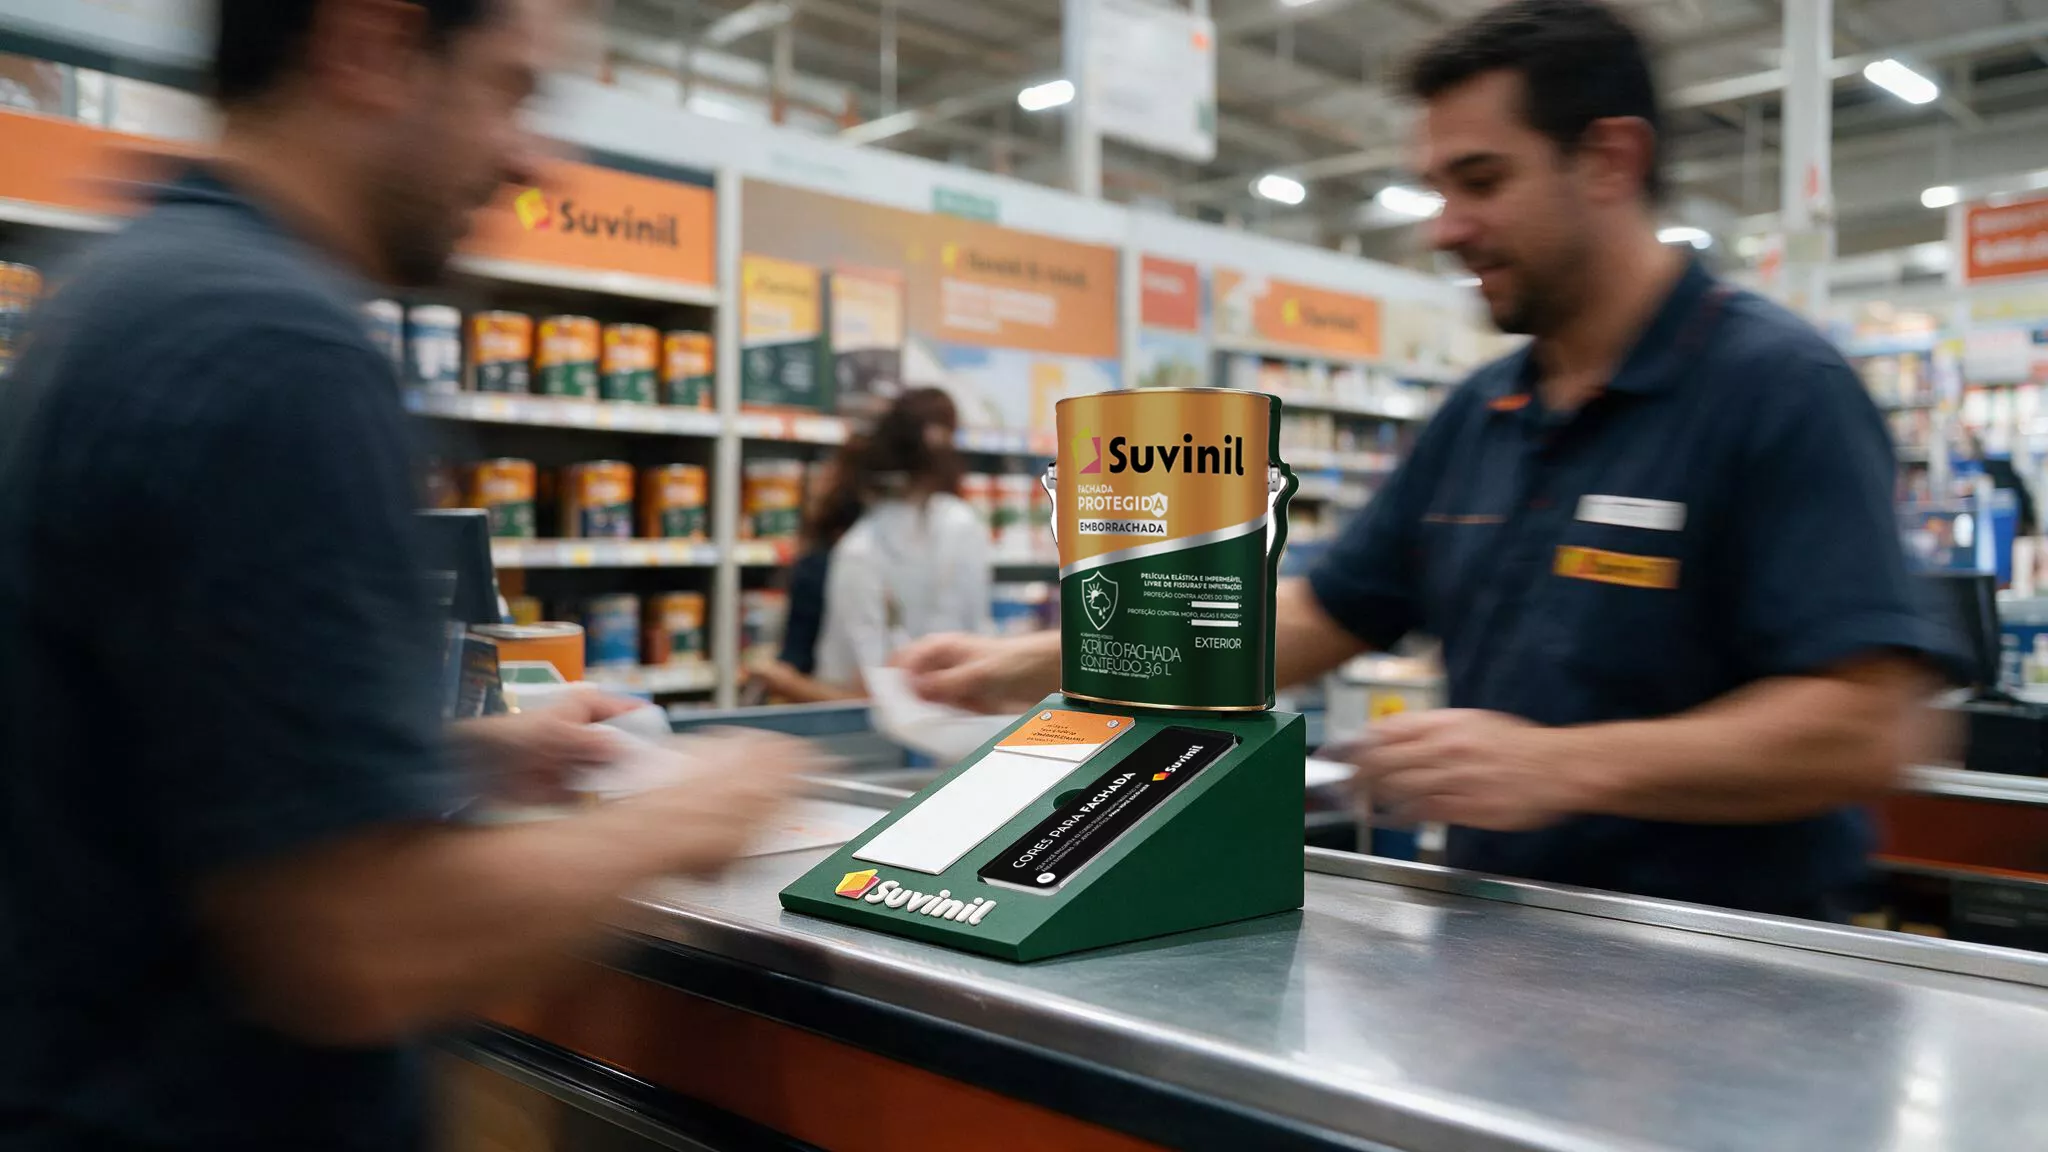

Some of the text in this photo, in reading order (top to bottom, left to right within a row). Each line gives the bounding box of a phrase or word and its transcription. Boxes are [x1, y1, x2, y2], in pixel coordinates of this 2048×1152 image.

[560, 199, 680, 247] Suvinil
[1109, 433, 1244, 476] Suvinil
[1078, 484, 1113, 494] FACHADA
[1078, 495, 1166, 513] PROTEGIDA
[1080, 522, 1164, 533] EMBORRACHADA
[1171, 573, 1198, 581] ELÁSTICA
[1124, 643, 1182, 662] FACHADA
[1194, 637, 1242, 649] EXTERIOR
[1081, 654, 1172, 676] CONTEÚDO 3,6 L
[1165, 745, 1204, 773] Suvinil
[1012, 838, 1053, 868] CORES
[1049, 812, 1085, 838] PARA
[1080, 771, 1136, 812] FACHADA
[864, 880, 997, 926] Suvinil
